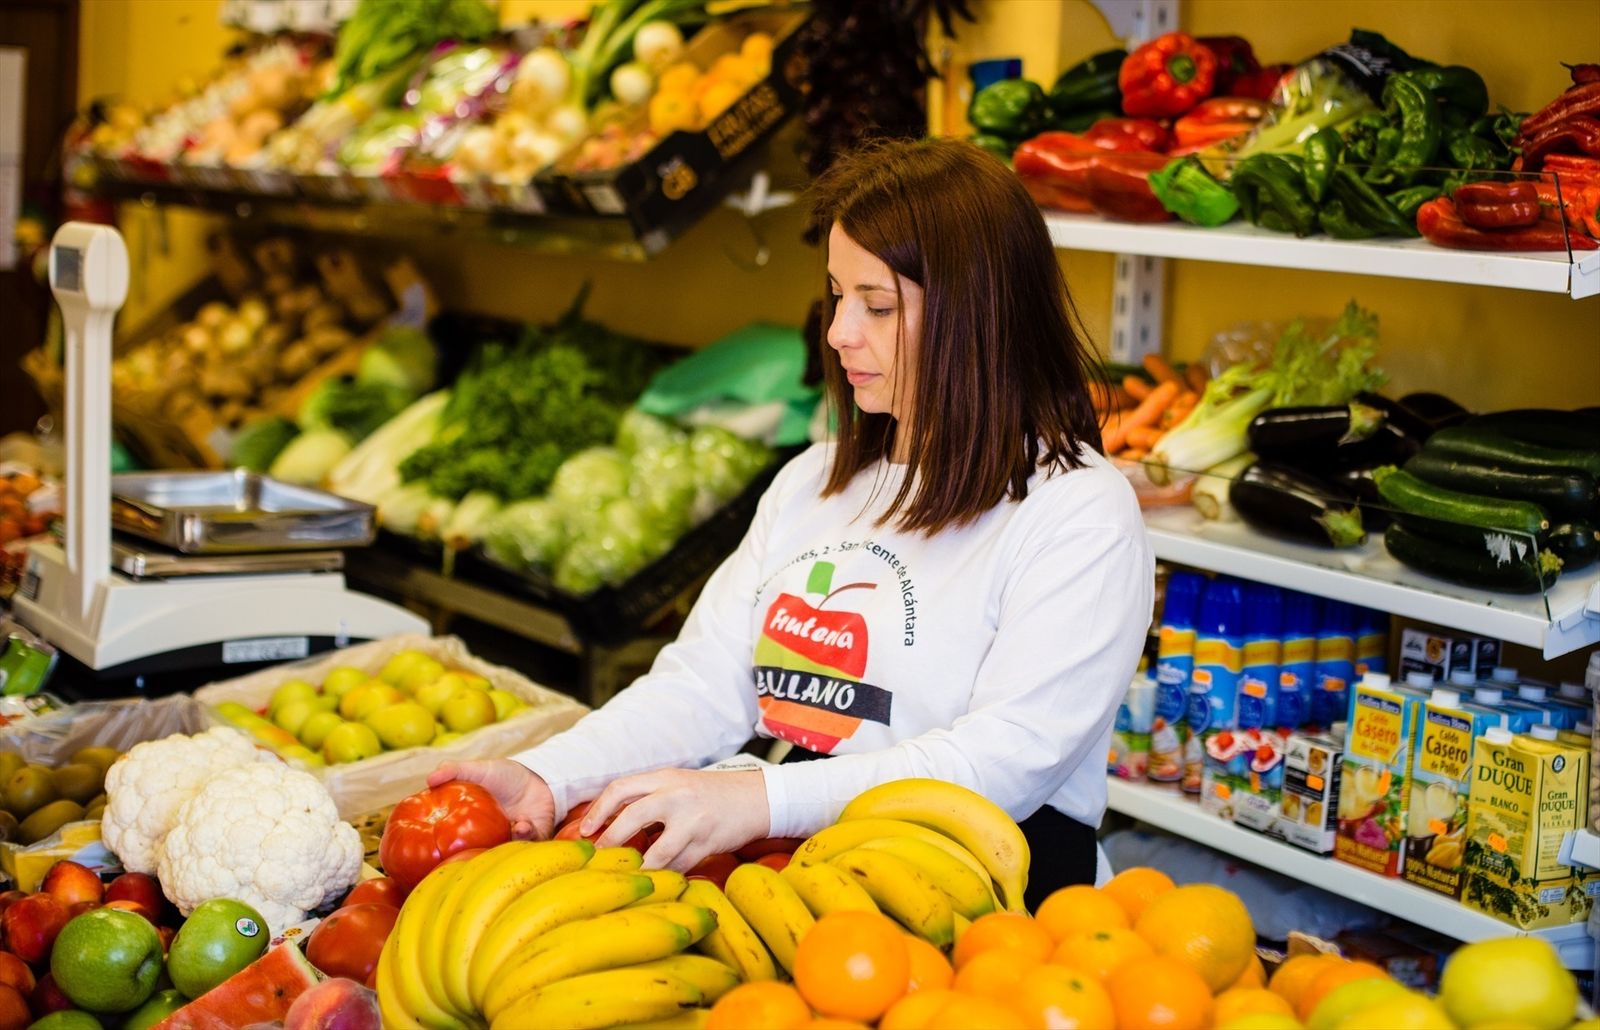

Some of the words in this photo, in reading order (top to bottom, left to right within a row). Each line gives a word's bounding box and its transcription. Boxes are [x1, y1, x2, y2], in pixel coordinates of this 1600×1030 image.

[896, 565, 908, 579] de
[900, 579, 918, 647] Alcántara
[1356, 717, 1398, 745] Casero
[1439, 730, 1459, 744] Caldo
[1426, 735, 1468, 764] Casero
[1430, 761, 1438, 769] de
[1440, 760, 1459, 775] Pollo
[1492, 750, 1525, 773] Gran
[1478, 765, 1533, 796] DUQUE
[1547, 790, 1568, 800] Gran
[1490, 796, 1519, 813] BLANCO
[1541, 800, 1575, 812] DUQUE
